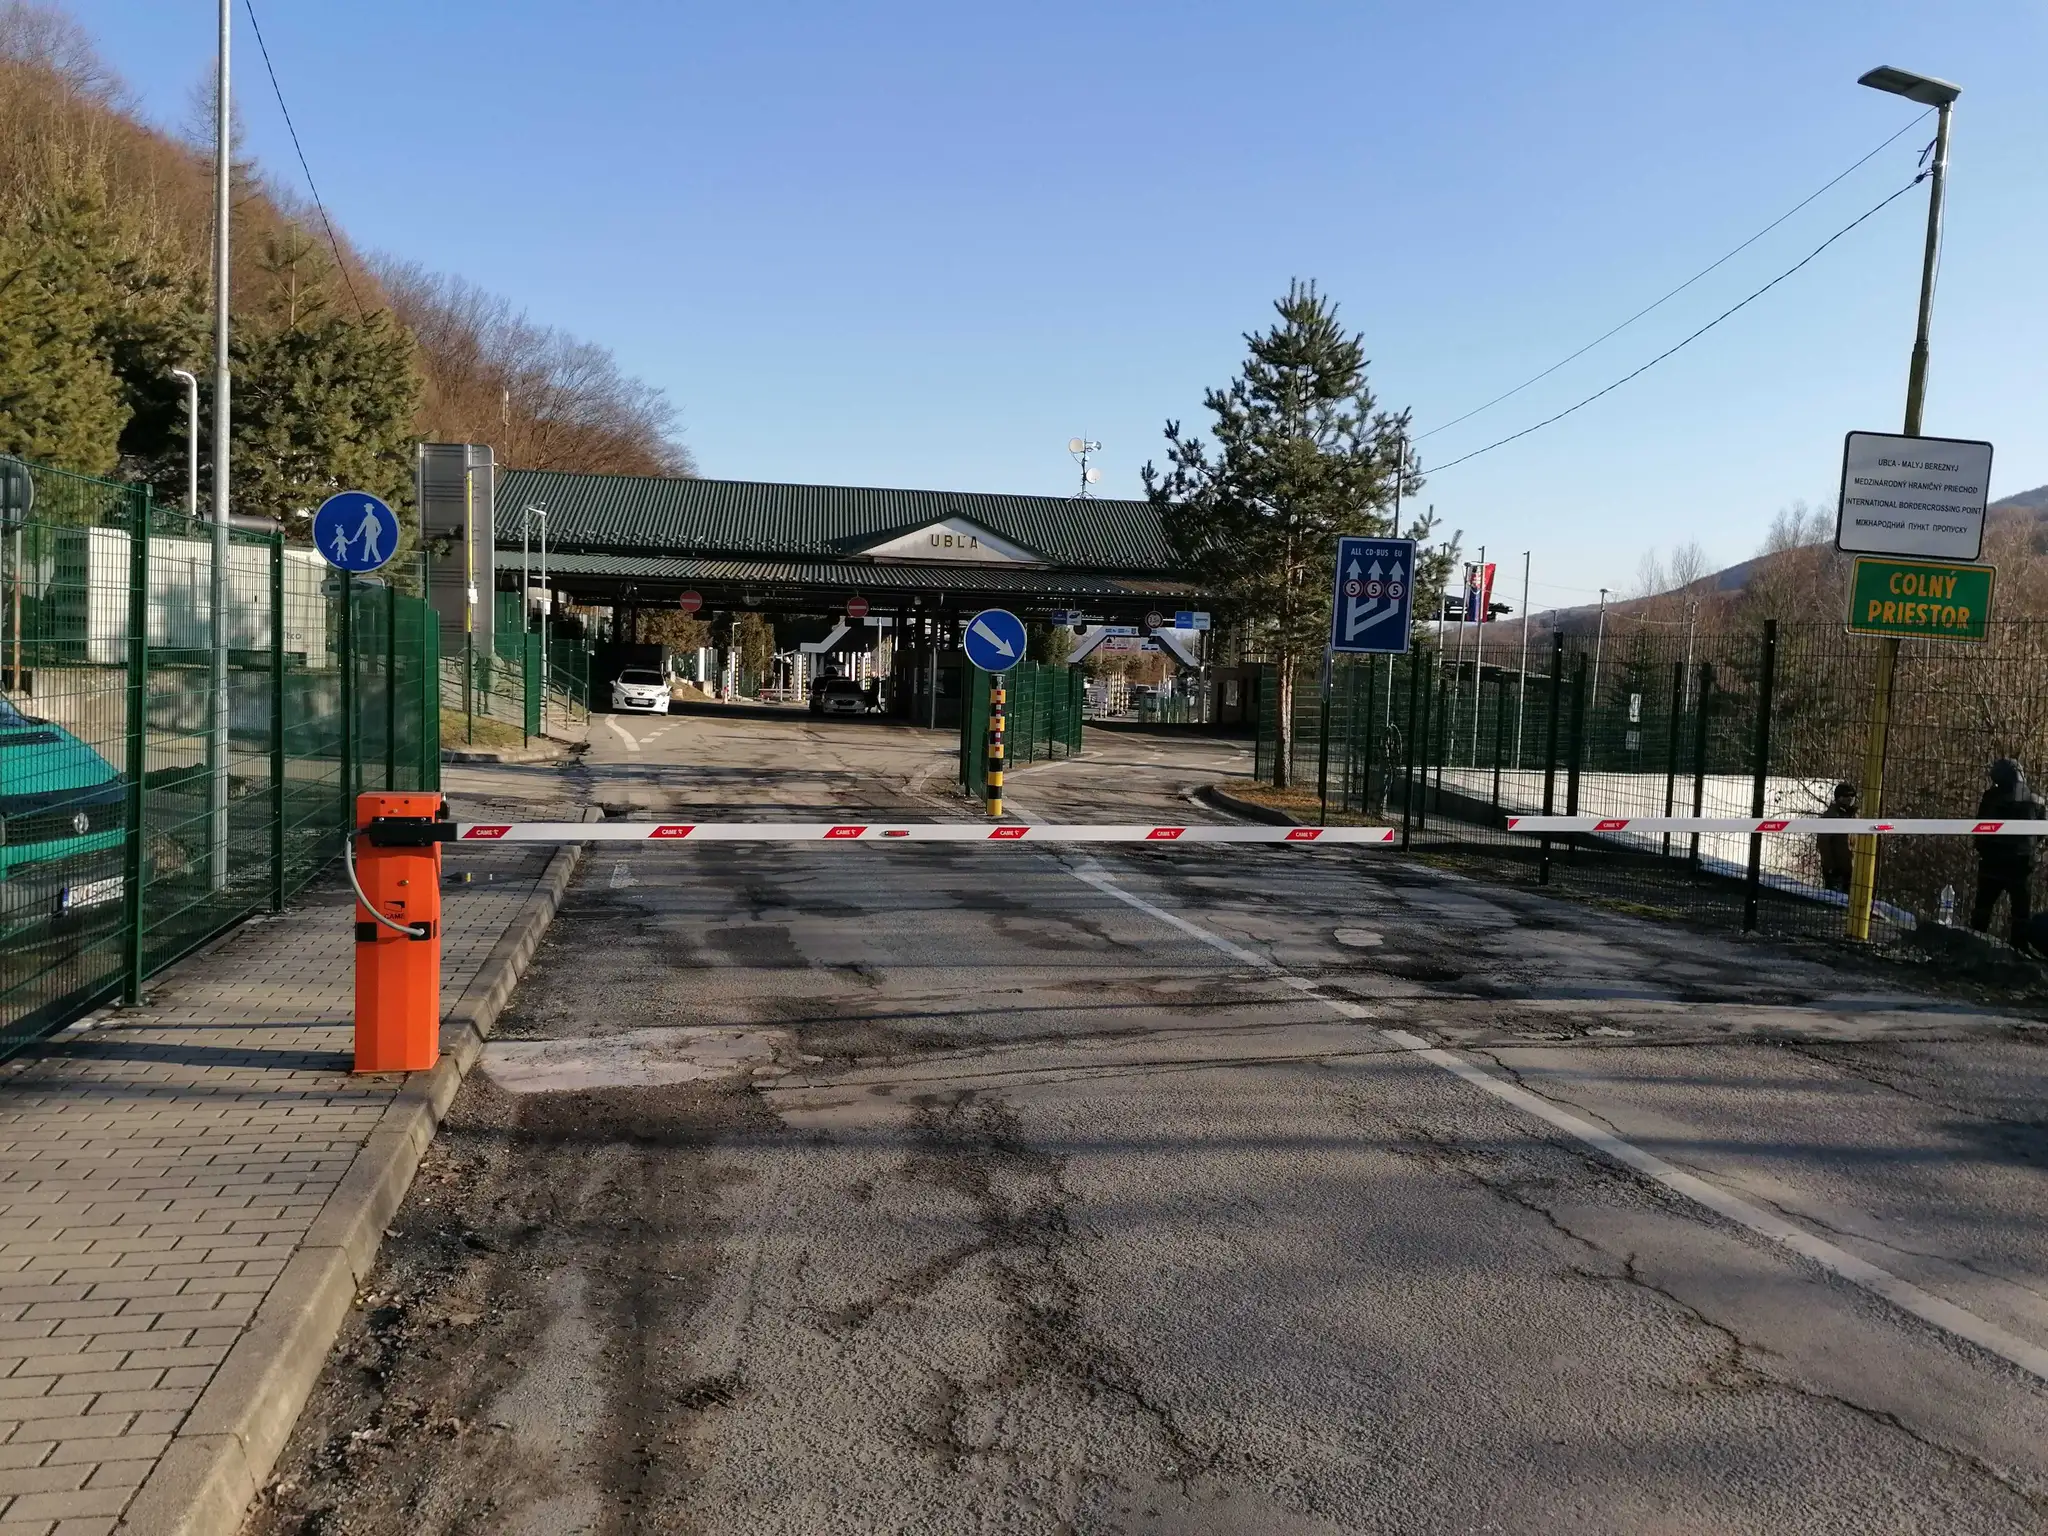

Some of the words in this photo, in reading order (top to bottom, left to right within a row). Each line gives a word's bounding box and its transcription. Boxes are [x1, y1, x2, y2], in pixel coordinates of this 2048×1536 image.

[1901, 460, 1924, 469] MALYJ
[1924, 462, 1960, 472] BEREZNYJ
[1854, 477, 1907, 488] MEDZINÁRODNÝ
[1908, 481, 1943, 491] HRANIČNÝ
[1943, 484, 1978, 494] PRIECHOD
[1846, 498, 1897, 509] INTERNATIONAL
[1899, 501, 1961, 513] BORDERCROSSING
[1961, 506, 1982, 515] POINT
[1908, 522, 1930, 531] ПУНКТ
[1932, 524, 1968, 534] ПРОПУСКУ
[1350, 547, 1362, 556] ALL
[1365, 548, 1389, 557] CD-BUS
[1394, 549, 1403, 557] EU
[1350, 583, 1356, 593] 5
[1371, 584, 1377, 594] 5
[1392, 585, 1399, 595] 5
[1889, 570, 1958, 599] COLNÝ
[1867, 599, 1970, 629] PRIESTOR
